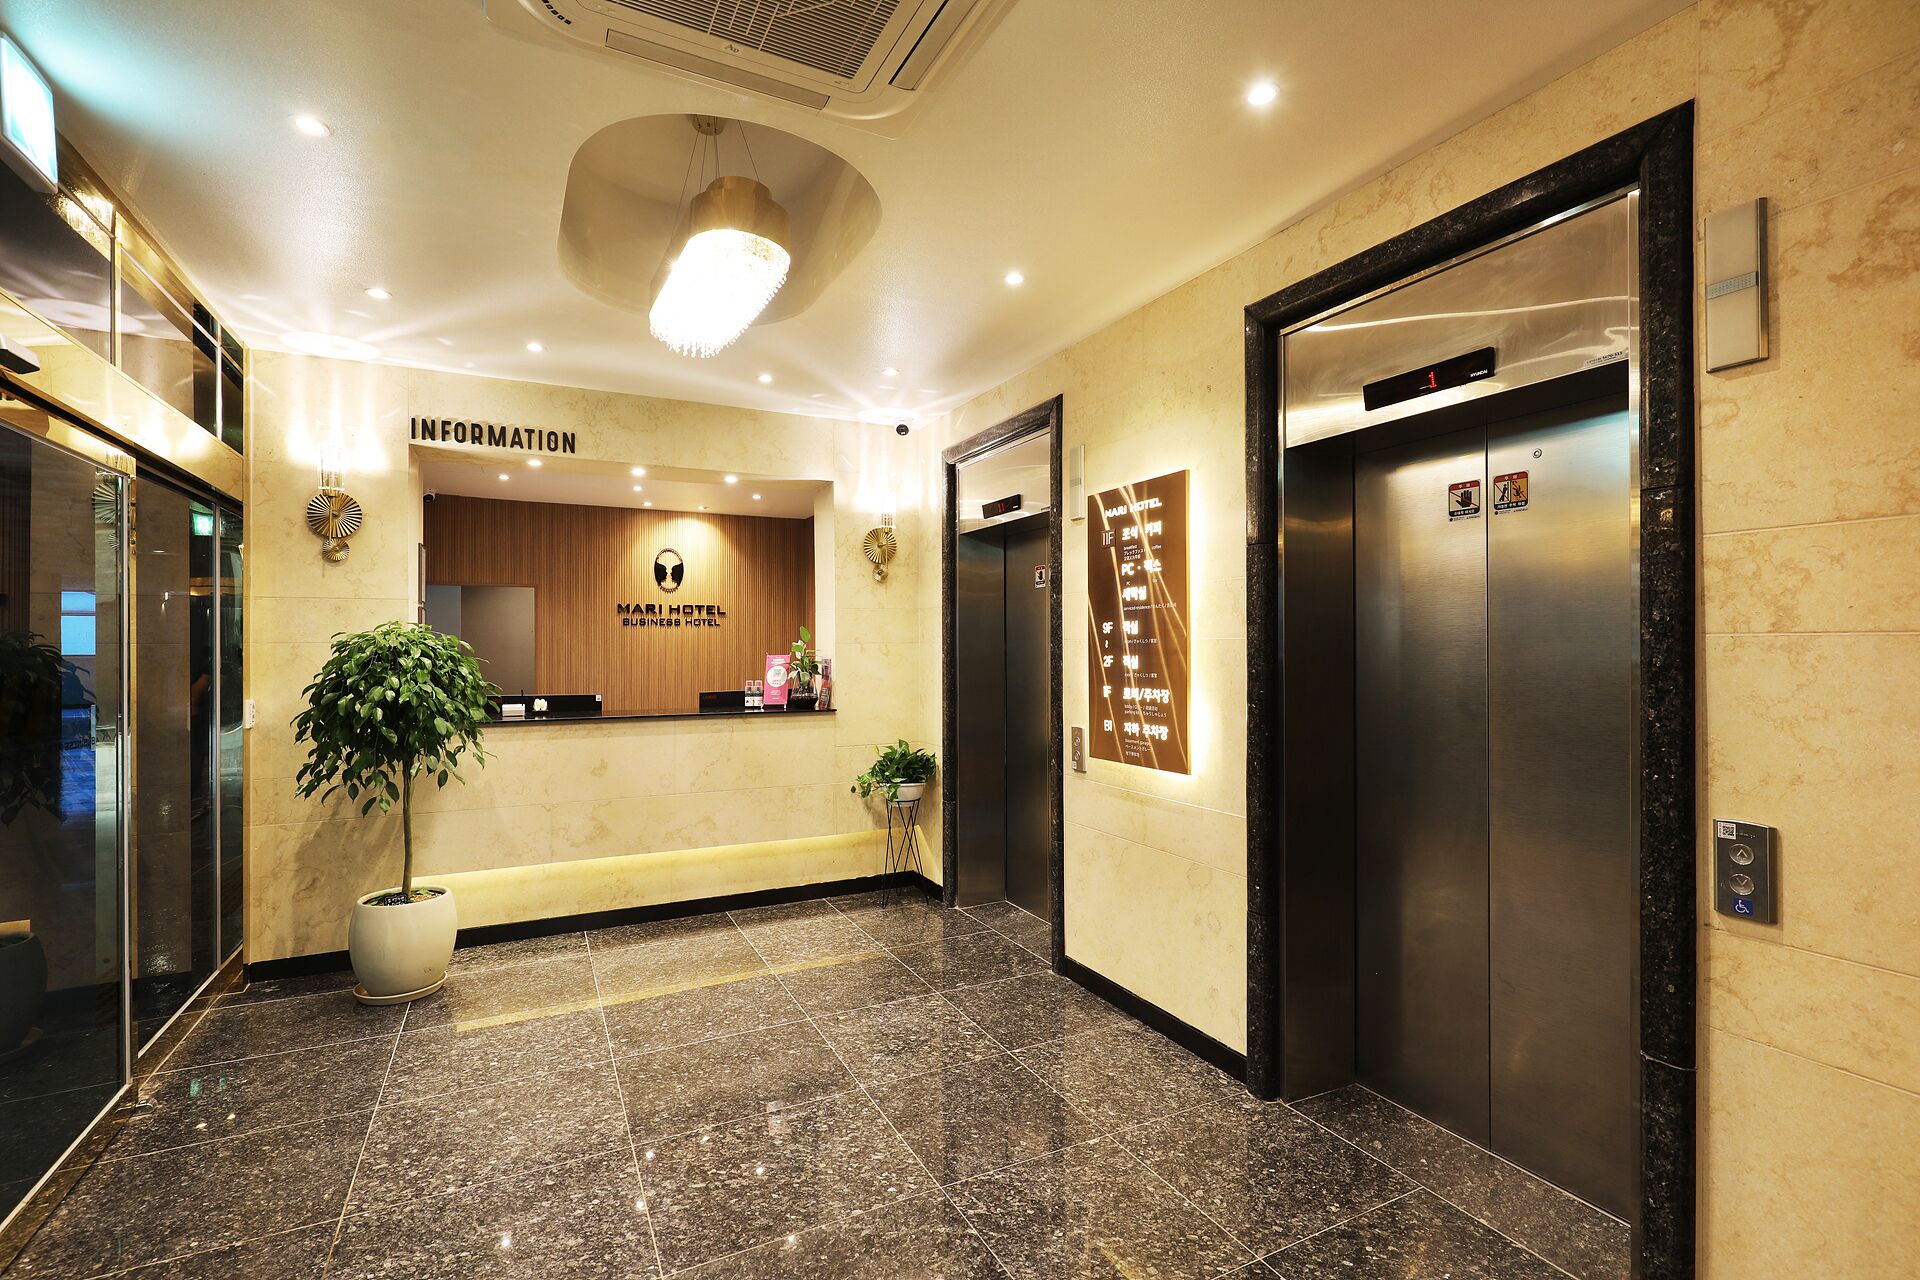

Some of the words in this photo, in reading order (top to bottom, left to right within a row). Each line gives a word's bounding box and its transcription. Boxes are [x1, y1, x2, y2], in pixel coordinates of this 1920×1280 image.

[1428, 371, 1437, 388] 1
[410, 417, 576, 454] INFORMATION
[1104, 505, 1127, 518] MARI
[1130, 497, 1162, 512] HOTEL
[1121, 562, 1135, 576] PC
[617, 603, 662, 615] MARI
[668, 604, 726, 616] HOTEL
[622, 618, 681, 626] BUSINESS
[685, 618, 720, 626] HOTEL
[1142, 723, 1169, 741] 주차장
